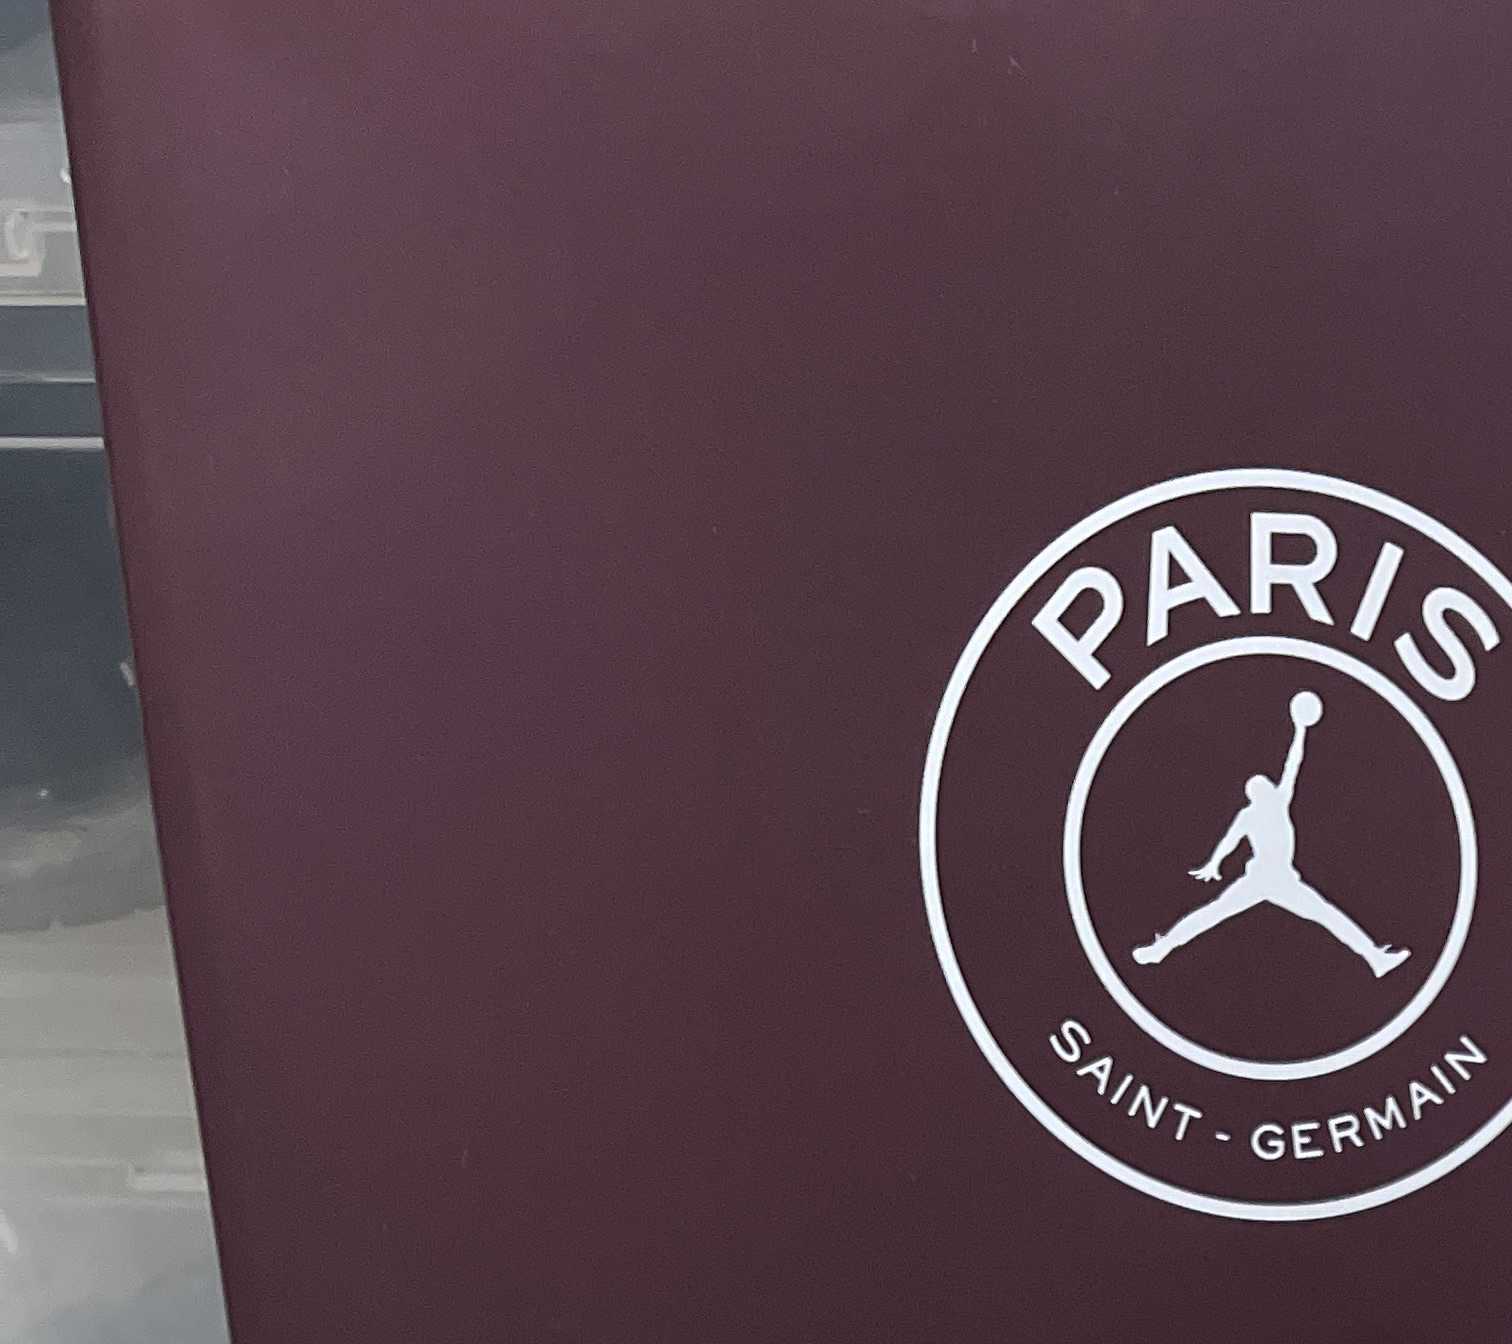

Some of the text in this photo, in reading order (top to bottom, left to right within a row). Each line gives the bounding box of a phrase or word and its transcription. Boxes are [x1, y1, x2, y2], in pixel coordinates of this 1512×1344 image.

[1031, 511, 1502, 702] PARIS
[1048, 1020, 1203, 1142] SAINT
[1251, 1034, 1489, 1161] GERMAIN
